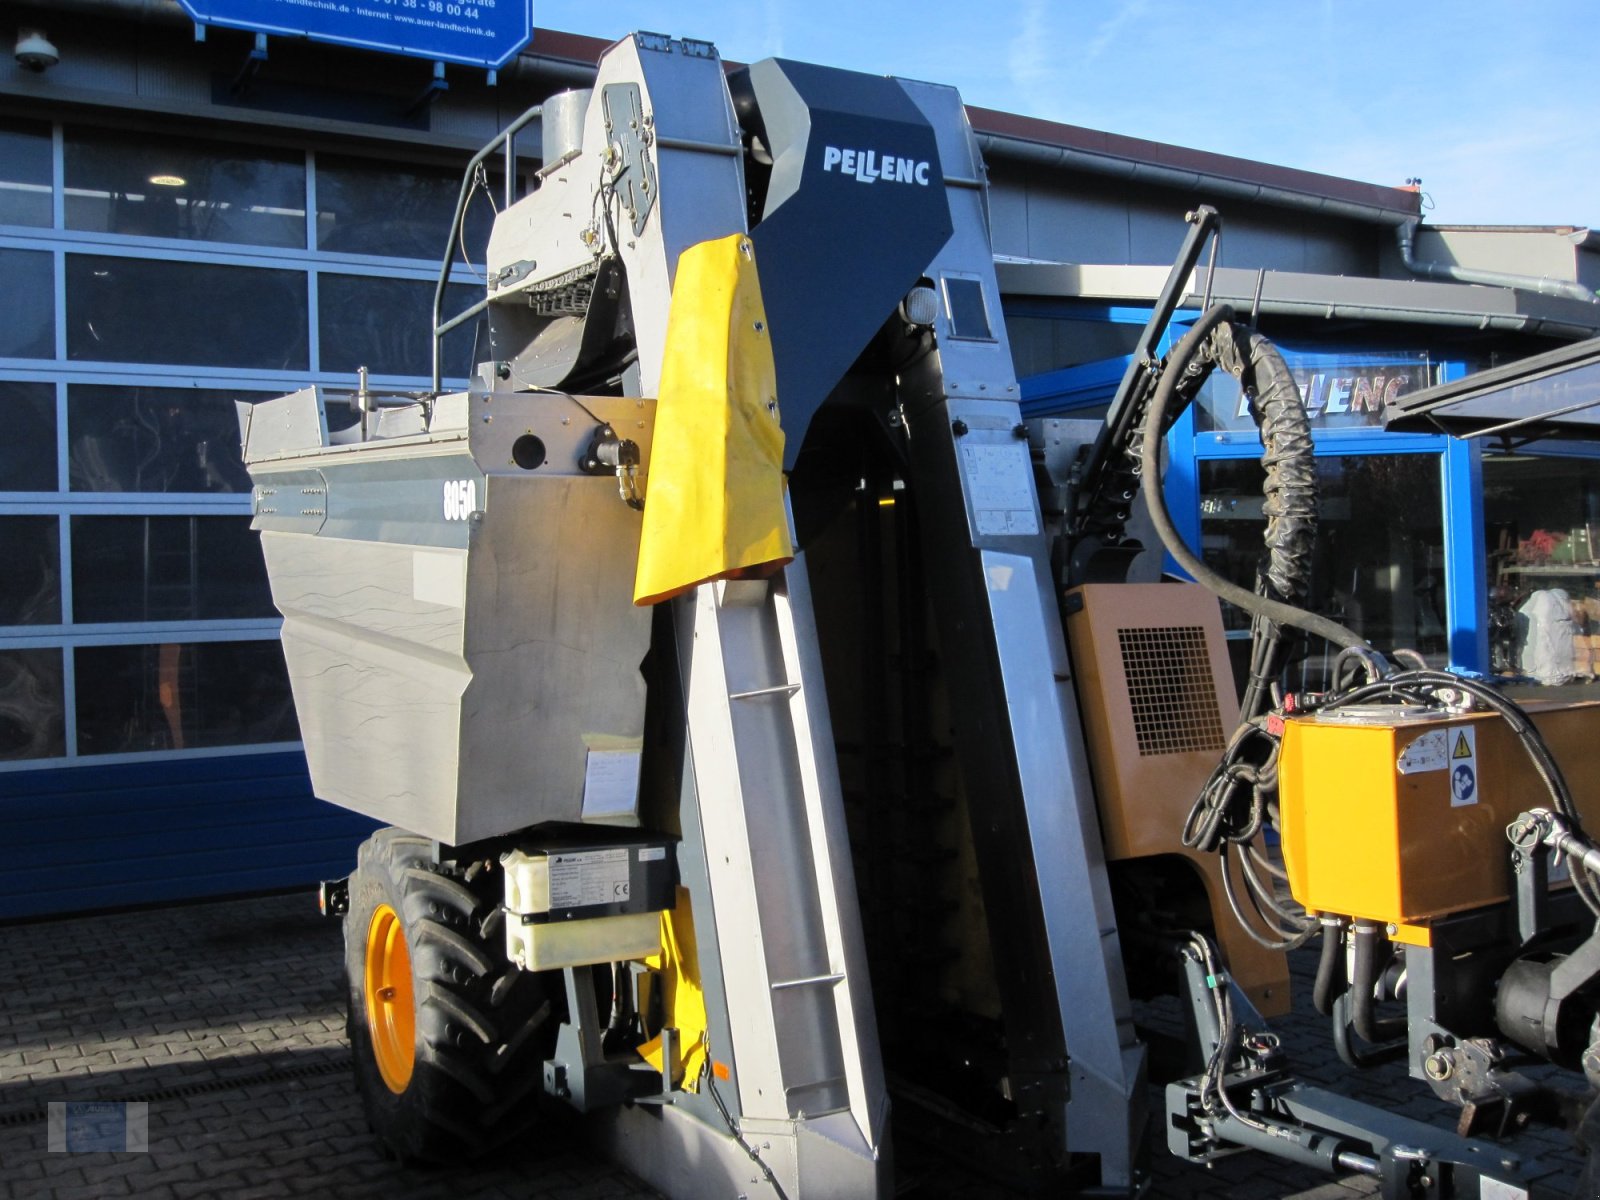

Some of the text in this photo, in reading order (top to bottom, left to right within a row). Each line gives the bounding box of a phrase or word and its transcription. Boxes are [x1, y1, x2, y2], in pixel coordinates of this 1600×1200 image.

[356, 7, 392, 20] Internet:
[394, 14, 496, 37] www.auer-landtechnik.de
[428, 0, 443, 13] 98
[446, 4, 461, 16] 00
[464, 7, 479, 19] 44
[823, 145, 930, 186] PELLENC
[443, 479, 476, 521] 8050
